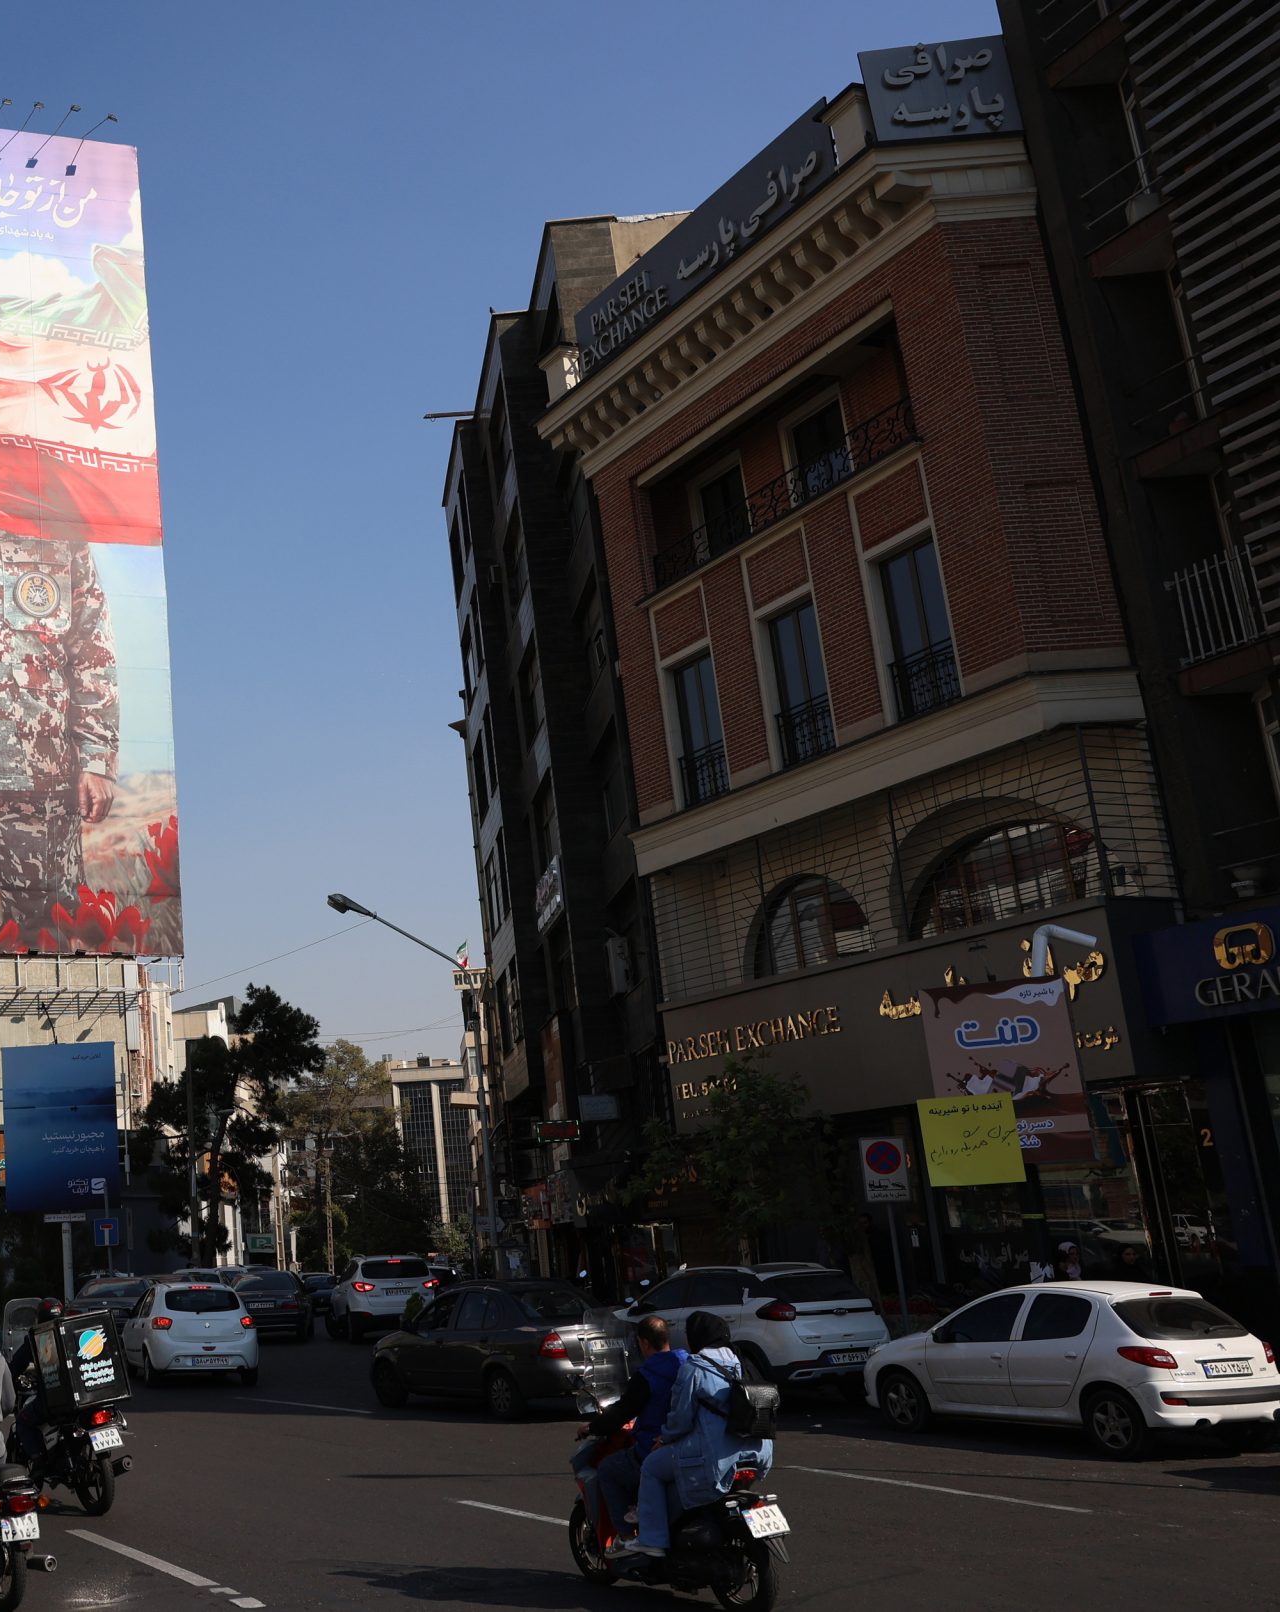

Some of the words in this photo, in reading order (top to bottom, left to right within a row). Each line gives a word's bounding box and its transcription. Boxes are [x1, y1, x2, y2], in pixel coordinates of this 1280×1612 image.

[884, 43, 993, 86] صرافی
[892, 86, 1005, 128] پارسه
[18, 176, 46, 209] تو
[37, 179, 66, 212] از
[53, 187, 97, 228] من
[740, 151, 817, 238] صرافی
[30, 229, 44, 241] یاد
[677, 216, 735, 280] پارسه
[591, 270, 650, 336] PARSEH
[581, 285, 668, 373] EXCHANGE
[1195, 966, 1280, 1007] GERA
[668, 1028, 732, 1065] PARSEH
[735, 1005, 842, 1052] EXCHANGE
[955, 1015, 1041, 1049] دنت
[928, 1105, 959, 1117] شیرینه
[961, 1104, 970, 1115] تو
[972, 1103, 979, 1111] با
[981, 1101, 1002, 1111] آینده
[42, 1130, 75, 1143] نیستید
[74, 1130, 105, 1143] مجبور
[1200, 1128, 1215, 1148] 2
